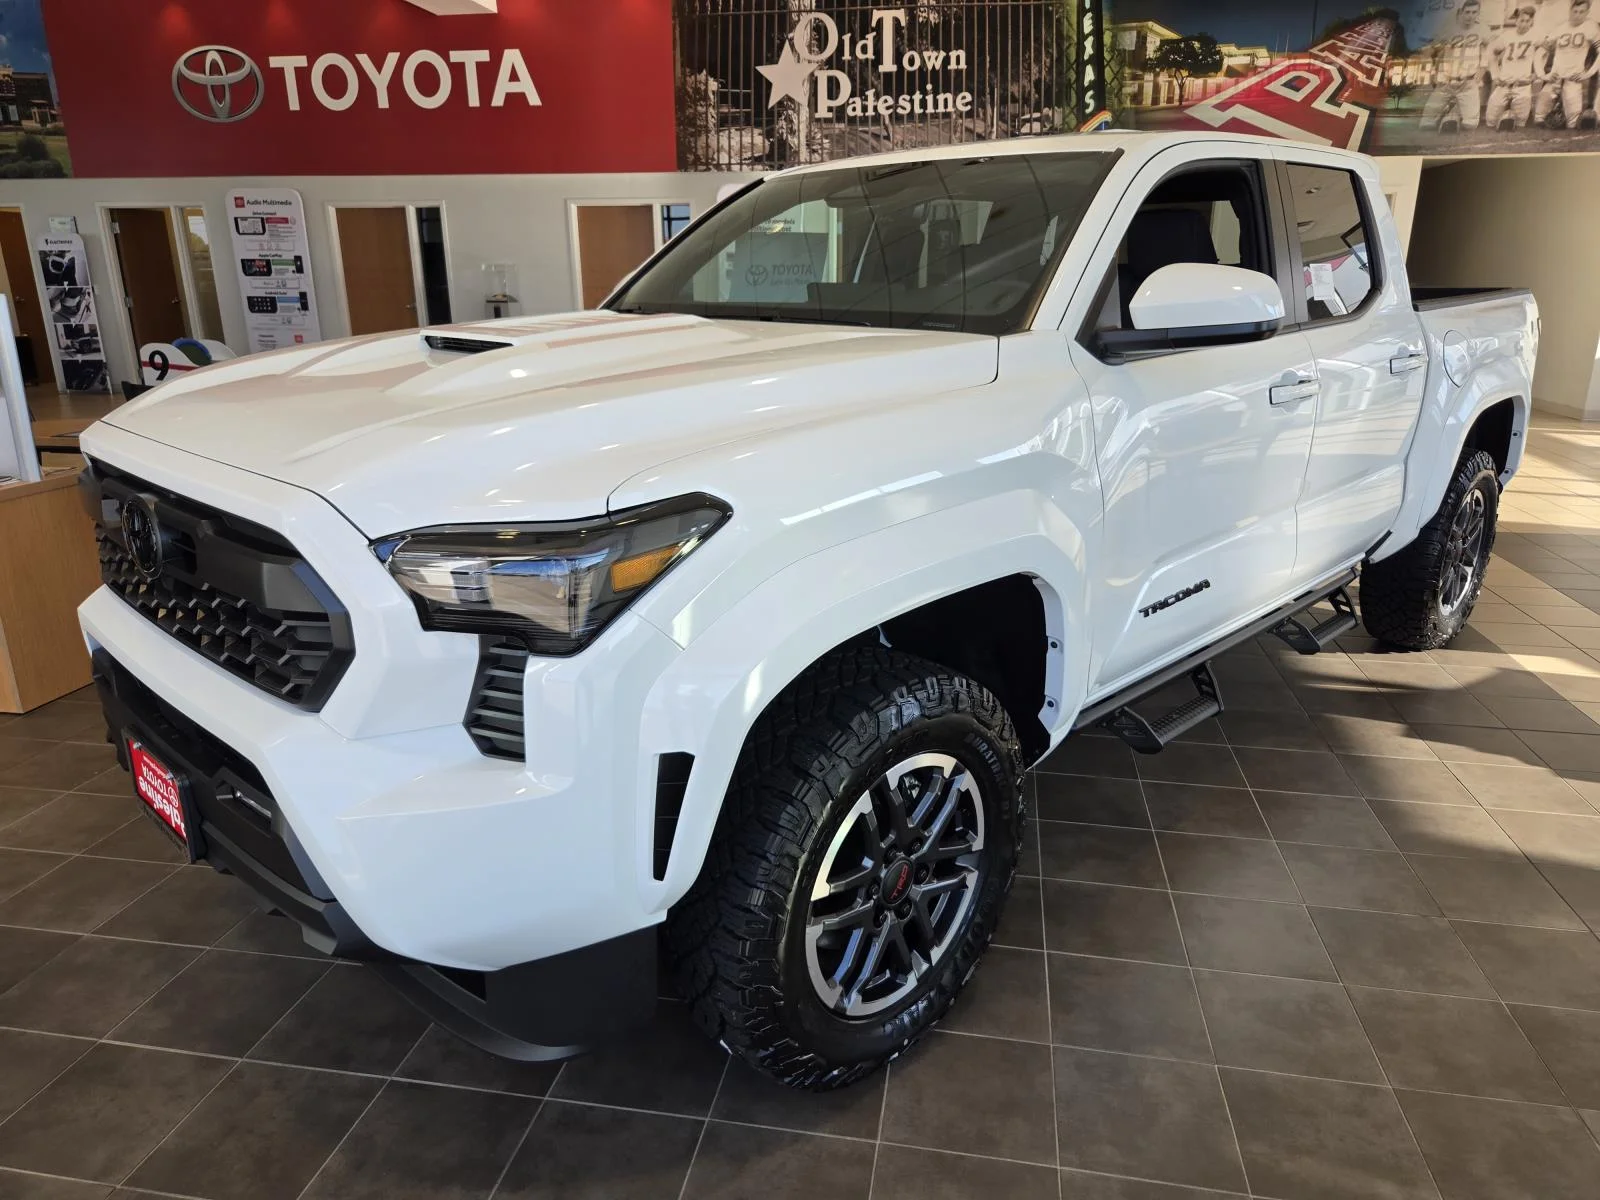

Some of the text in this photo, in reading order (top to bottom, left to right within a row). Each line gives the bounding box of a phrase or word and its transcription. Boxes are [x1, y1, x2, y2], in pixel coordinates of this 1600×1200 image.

[793, 8, 967, 73] Old Town
[1507, 41, 1531, 61] 17
[1558, 32, 1585, 48] 30
[269, 49, 542, 111] TOYOTA
[814, 69, 973, 119] Palestine
[772, 263, 813, 276] TOYOTA
[148, 349, 170, 381] 9
[1138, 578, 1211, 618] TACOMA
[888, 863, 909, 900] TRD
